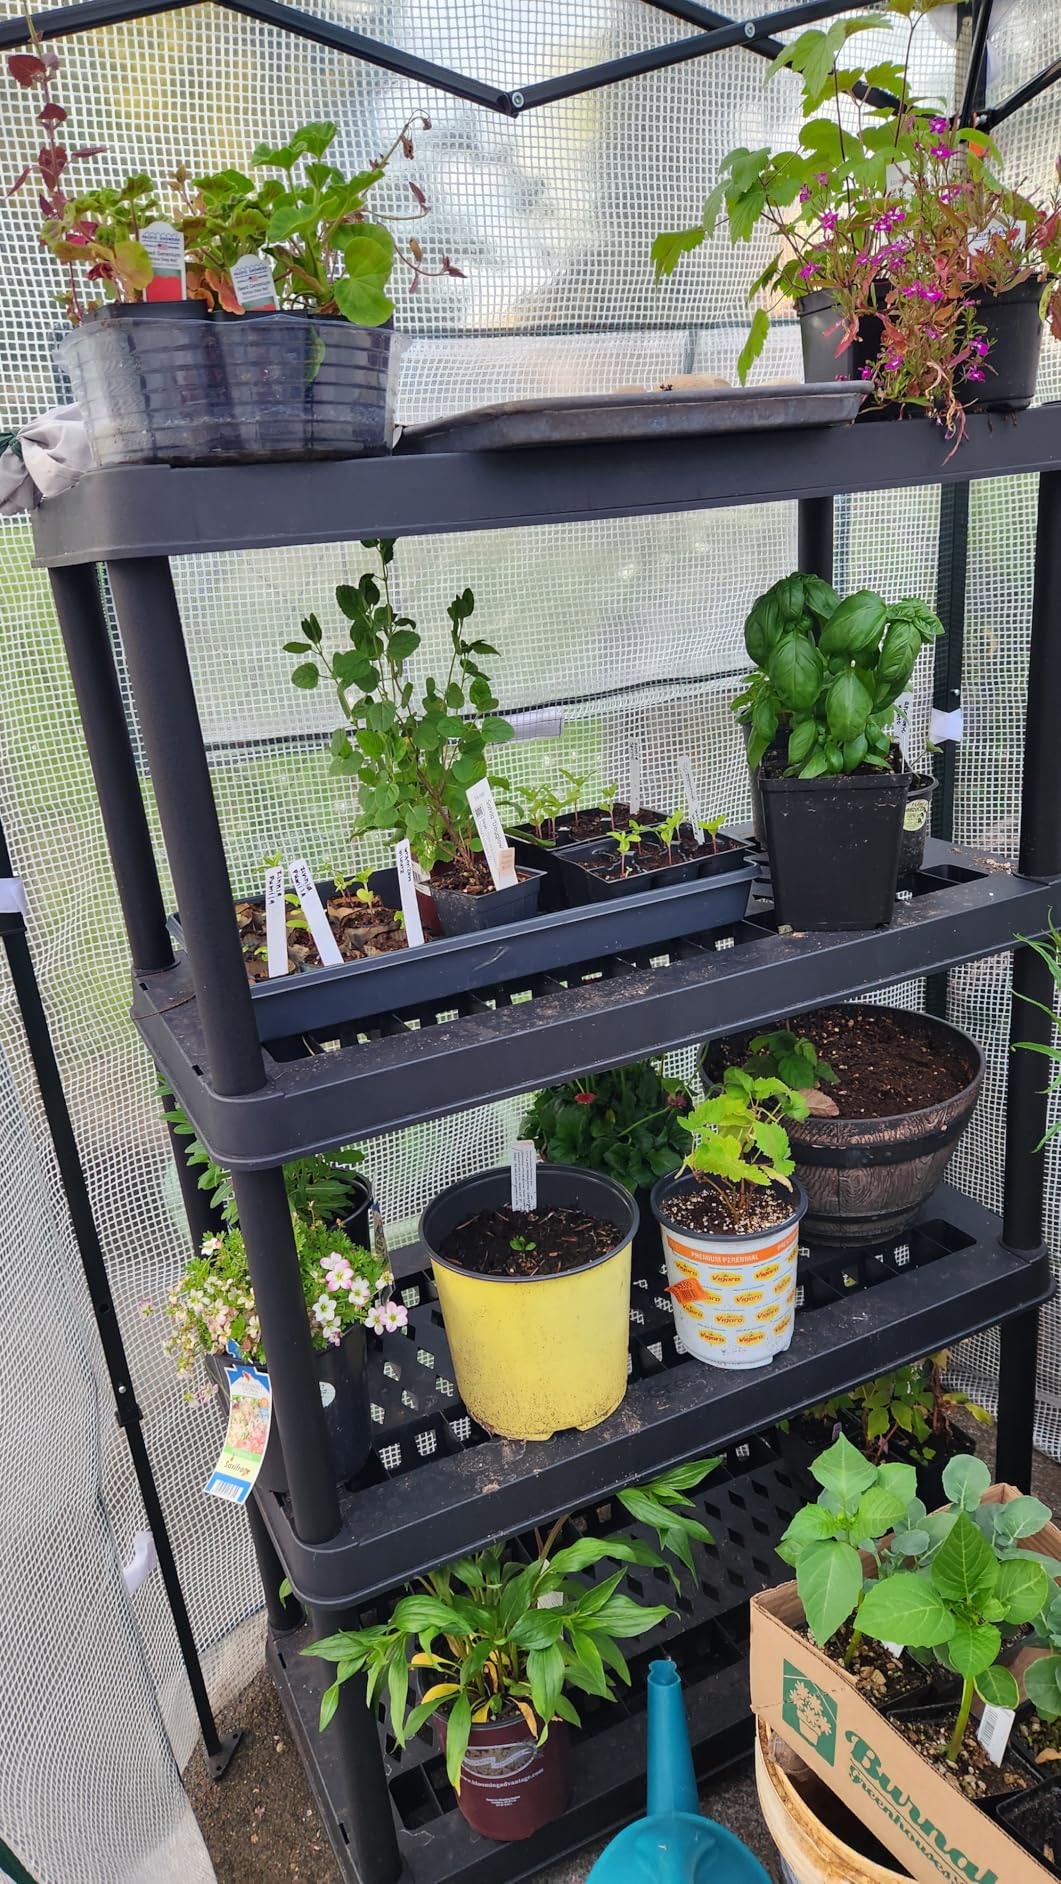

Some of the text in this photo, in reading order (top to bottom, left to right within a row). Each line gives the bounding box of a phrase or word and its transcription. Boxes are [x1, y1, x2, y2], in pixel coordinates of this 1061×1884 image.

[690, 1251, 720, 1263] PREMIUM
[721, 1254, 759, 1263] PERENNIAL
[675, 1262, 698, 1276] Vigoro
[755, 1266, 779, 1279] Vigoro
[712, 1274, 741, 1283] Vigoro
[736, 1294, 763, 1303] Vigoro
[716, 1314, 743, 1324] Vigoro
[757, 1308, 778, 1319] Vigoro
[700, 1331, 725, 1342] Vigoro
[739, 1334, 764, 1343] Vigoro
